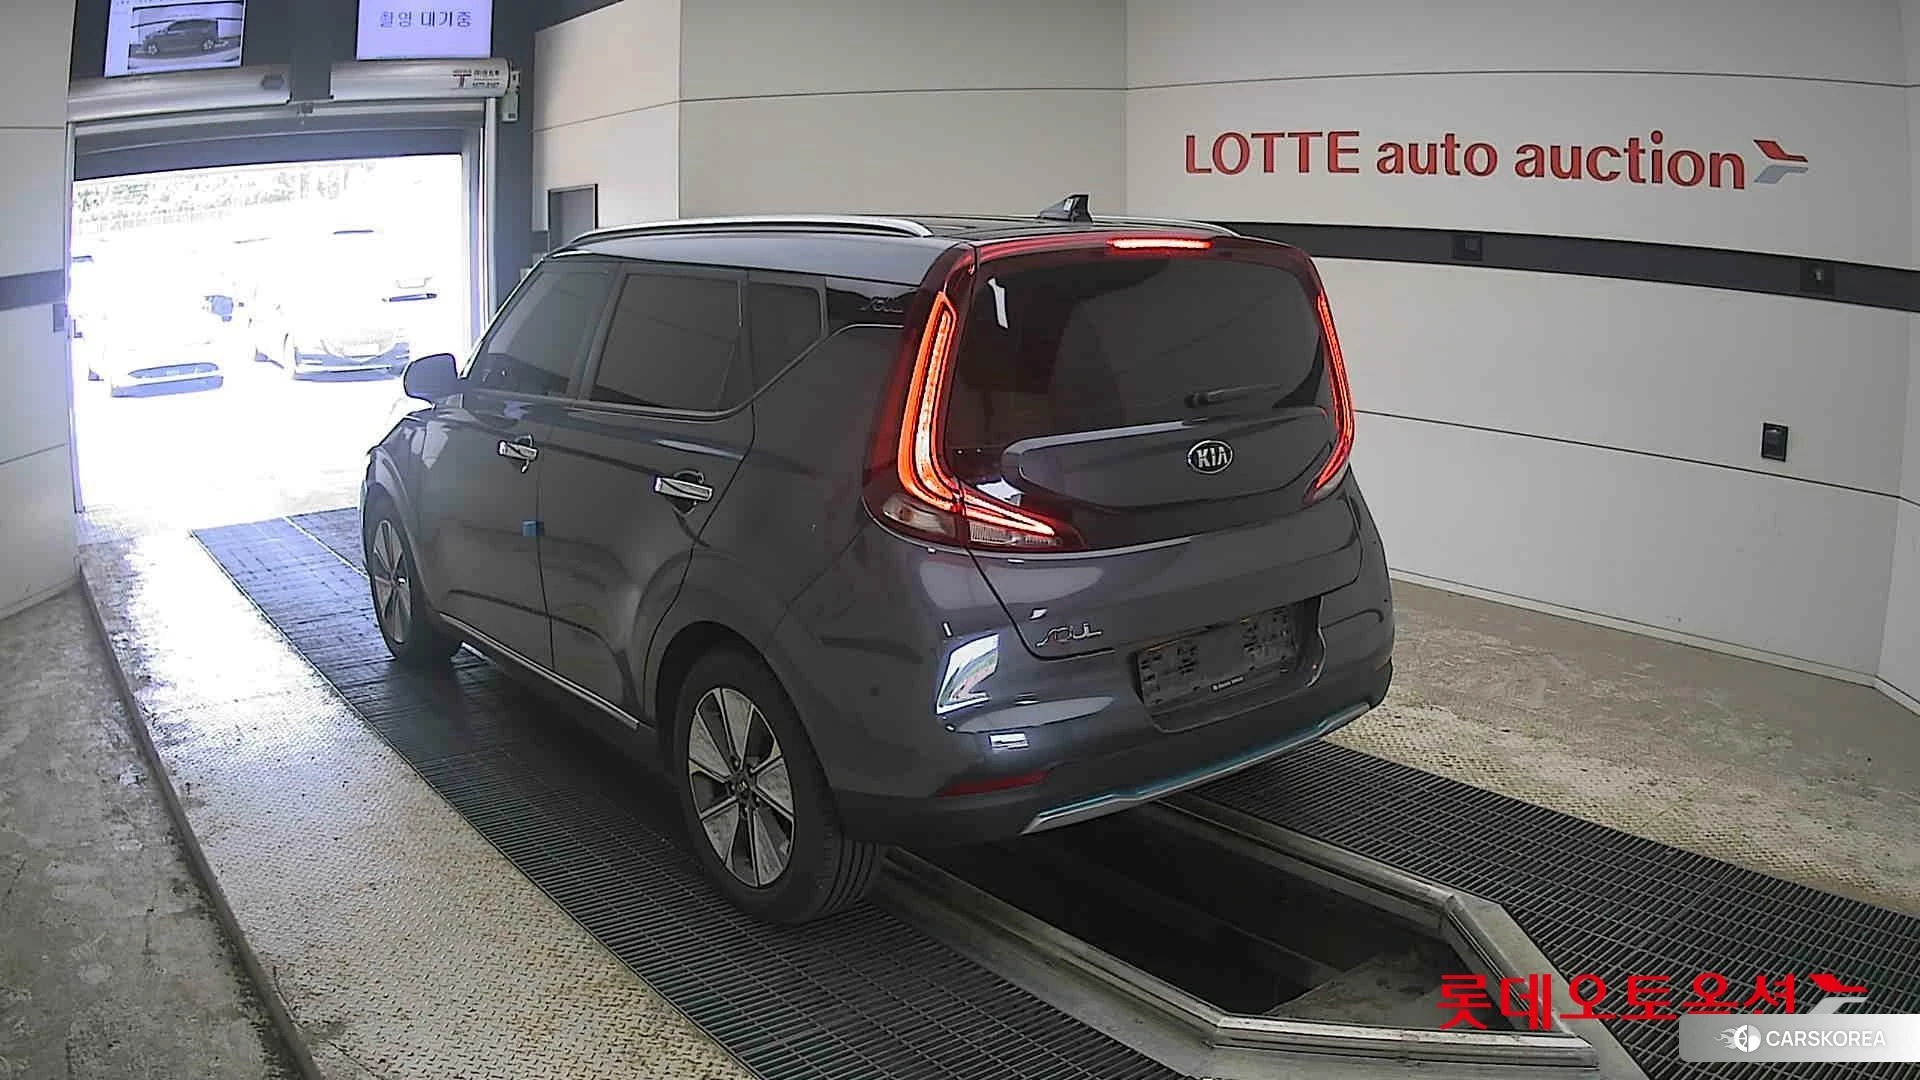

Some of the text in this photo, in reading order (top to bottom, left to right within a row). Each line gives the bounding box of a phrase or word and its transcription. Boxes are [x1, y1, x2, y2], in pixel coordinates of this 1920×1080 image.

[421, 11, 471, 28] 대기중
[1185, 130, 1745, 190] LOTTE auto auction
[1196, 446, 1228, 468] KIA
